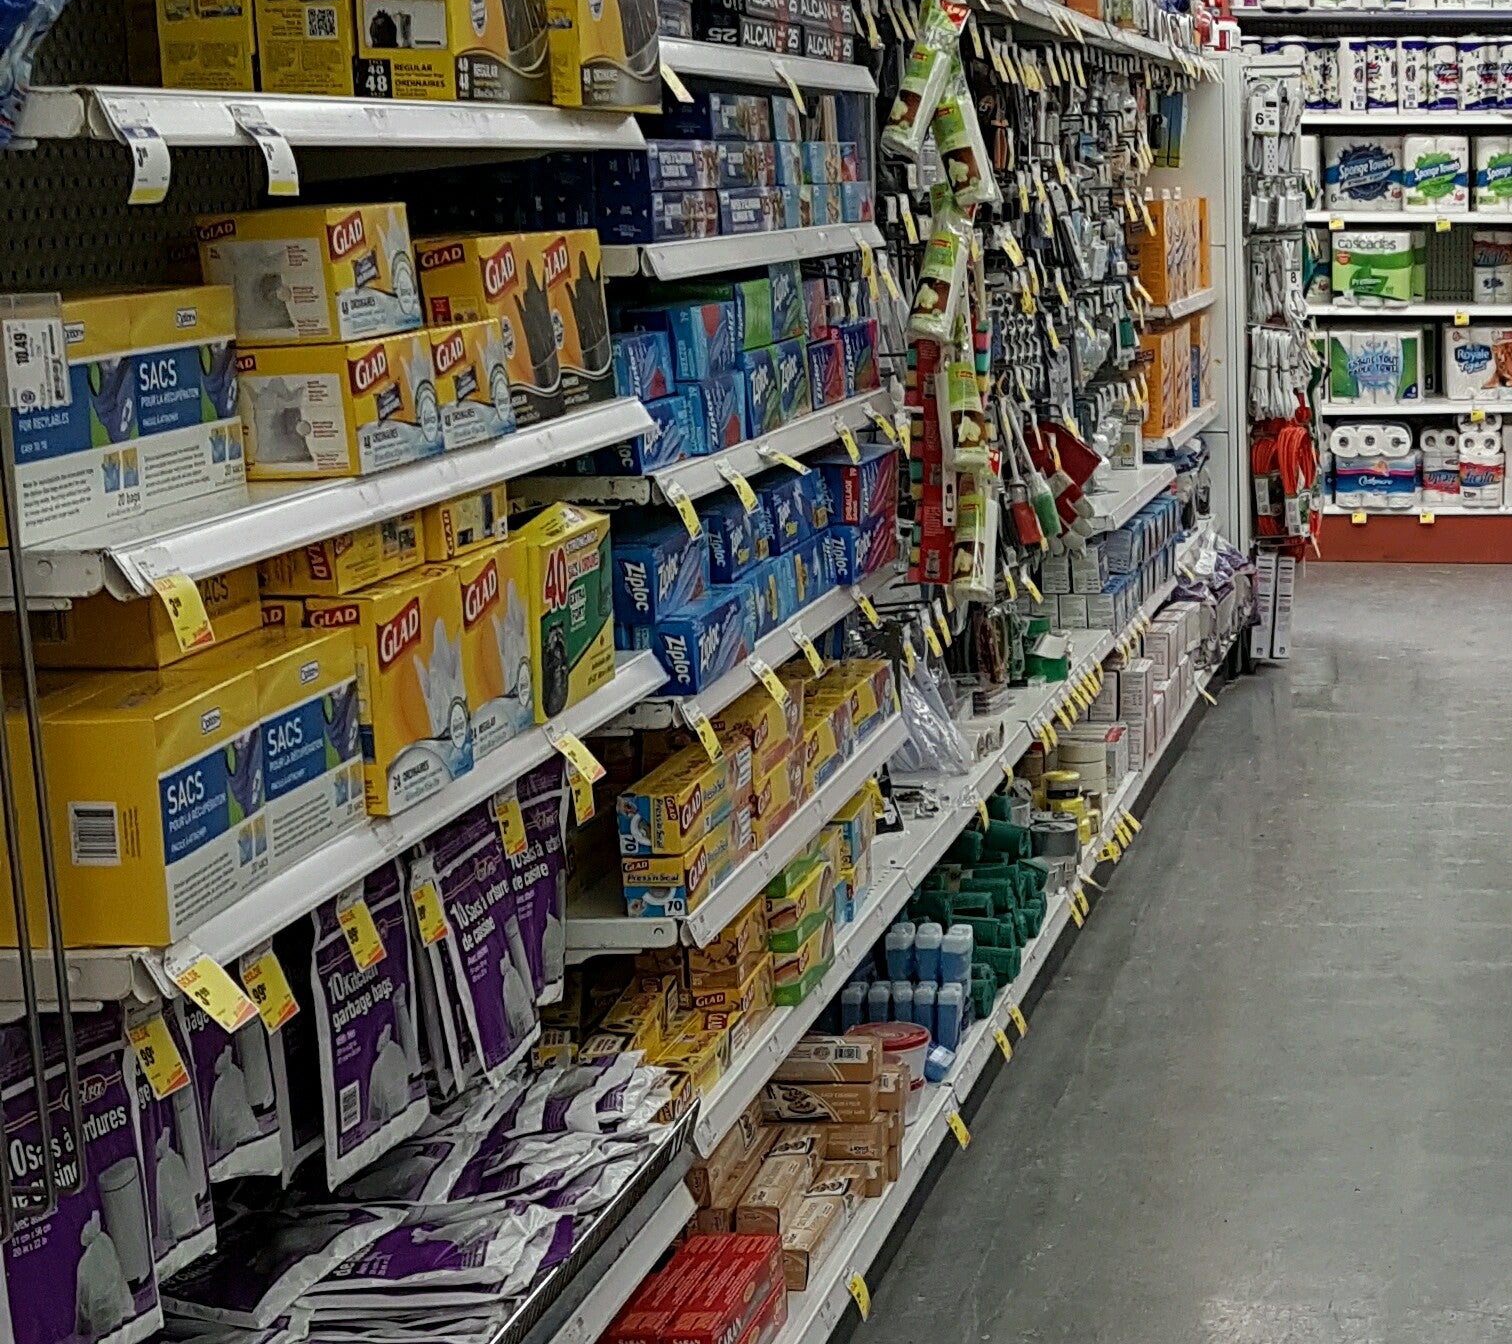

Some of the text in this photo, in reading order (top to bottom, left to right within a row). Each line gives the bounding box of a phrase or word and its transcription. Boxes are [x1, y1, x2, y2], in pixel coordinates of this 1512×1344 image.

[743, 23, 777, 49] ALCAN
[807, 34, 834, 57] ALCAN
[365, 75, 388, 92] 48
[1255, 112, 1264, 127] 6
[200, 222, 235, 240] GLAD
[333, 215, 364, 258] GLAD
[1337, 236, 1397, 251] cascades
[421, 248, 461, 269] GLAD
[485, 250, 516, 296] GLAD
[355, 351, 387, 391] GLAD
[436, 336, 464, 373] GLAD
[1457, 348, 1491, 362] Royale
[139, 358, 177, 391] SACS
[708, 531, 727, 568] Ziploc
[830, 535, 848, 576] Ziploc
[465, 568, 499, 623] GLAD
[544, 547, 568, 610] 40
[624, 560, 650, 613] Ziploc
[309, 608, 358, 627] GLAD
[380, 605, 419, 663] GLAD
[664, 634, 691, 686] Ziploc
[267, 716, 303, 756] SACS
[167, 771, 205, 814] SACS
[681, 789, 701, 831] GLAD
[624, 860, 650, 872] GLAD
[689, 851, 707, 891] GLAD
[452, 899, 468, 931] 10
[667, 899, 684, 913] 70
[462, 916, 497, 952] de cuisine
[328, 971, 345, 1007] 10
[332, 980, 395, 1033] garbage bags
[696, 993, 725, 1007] GLAD
